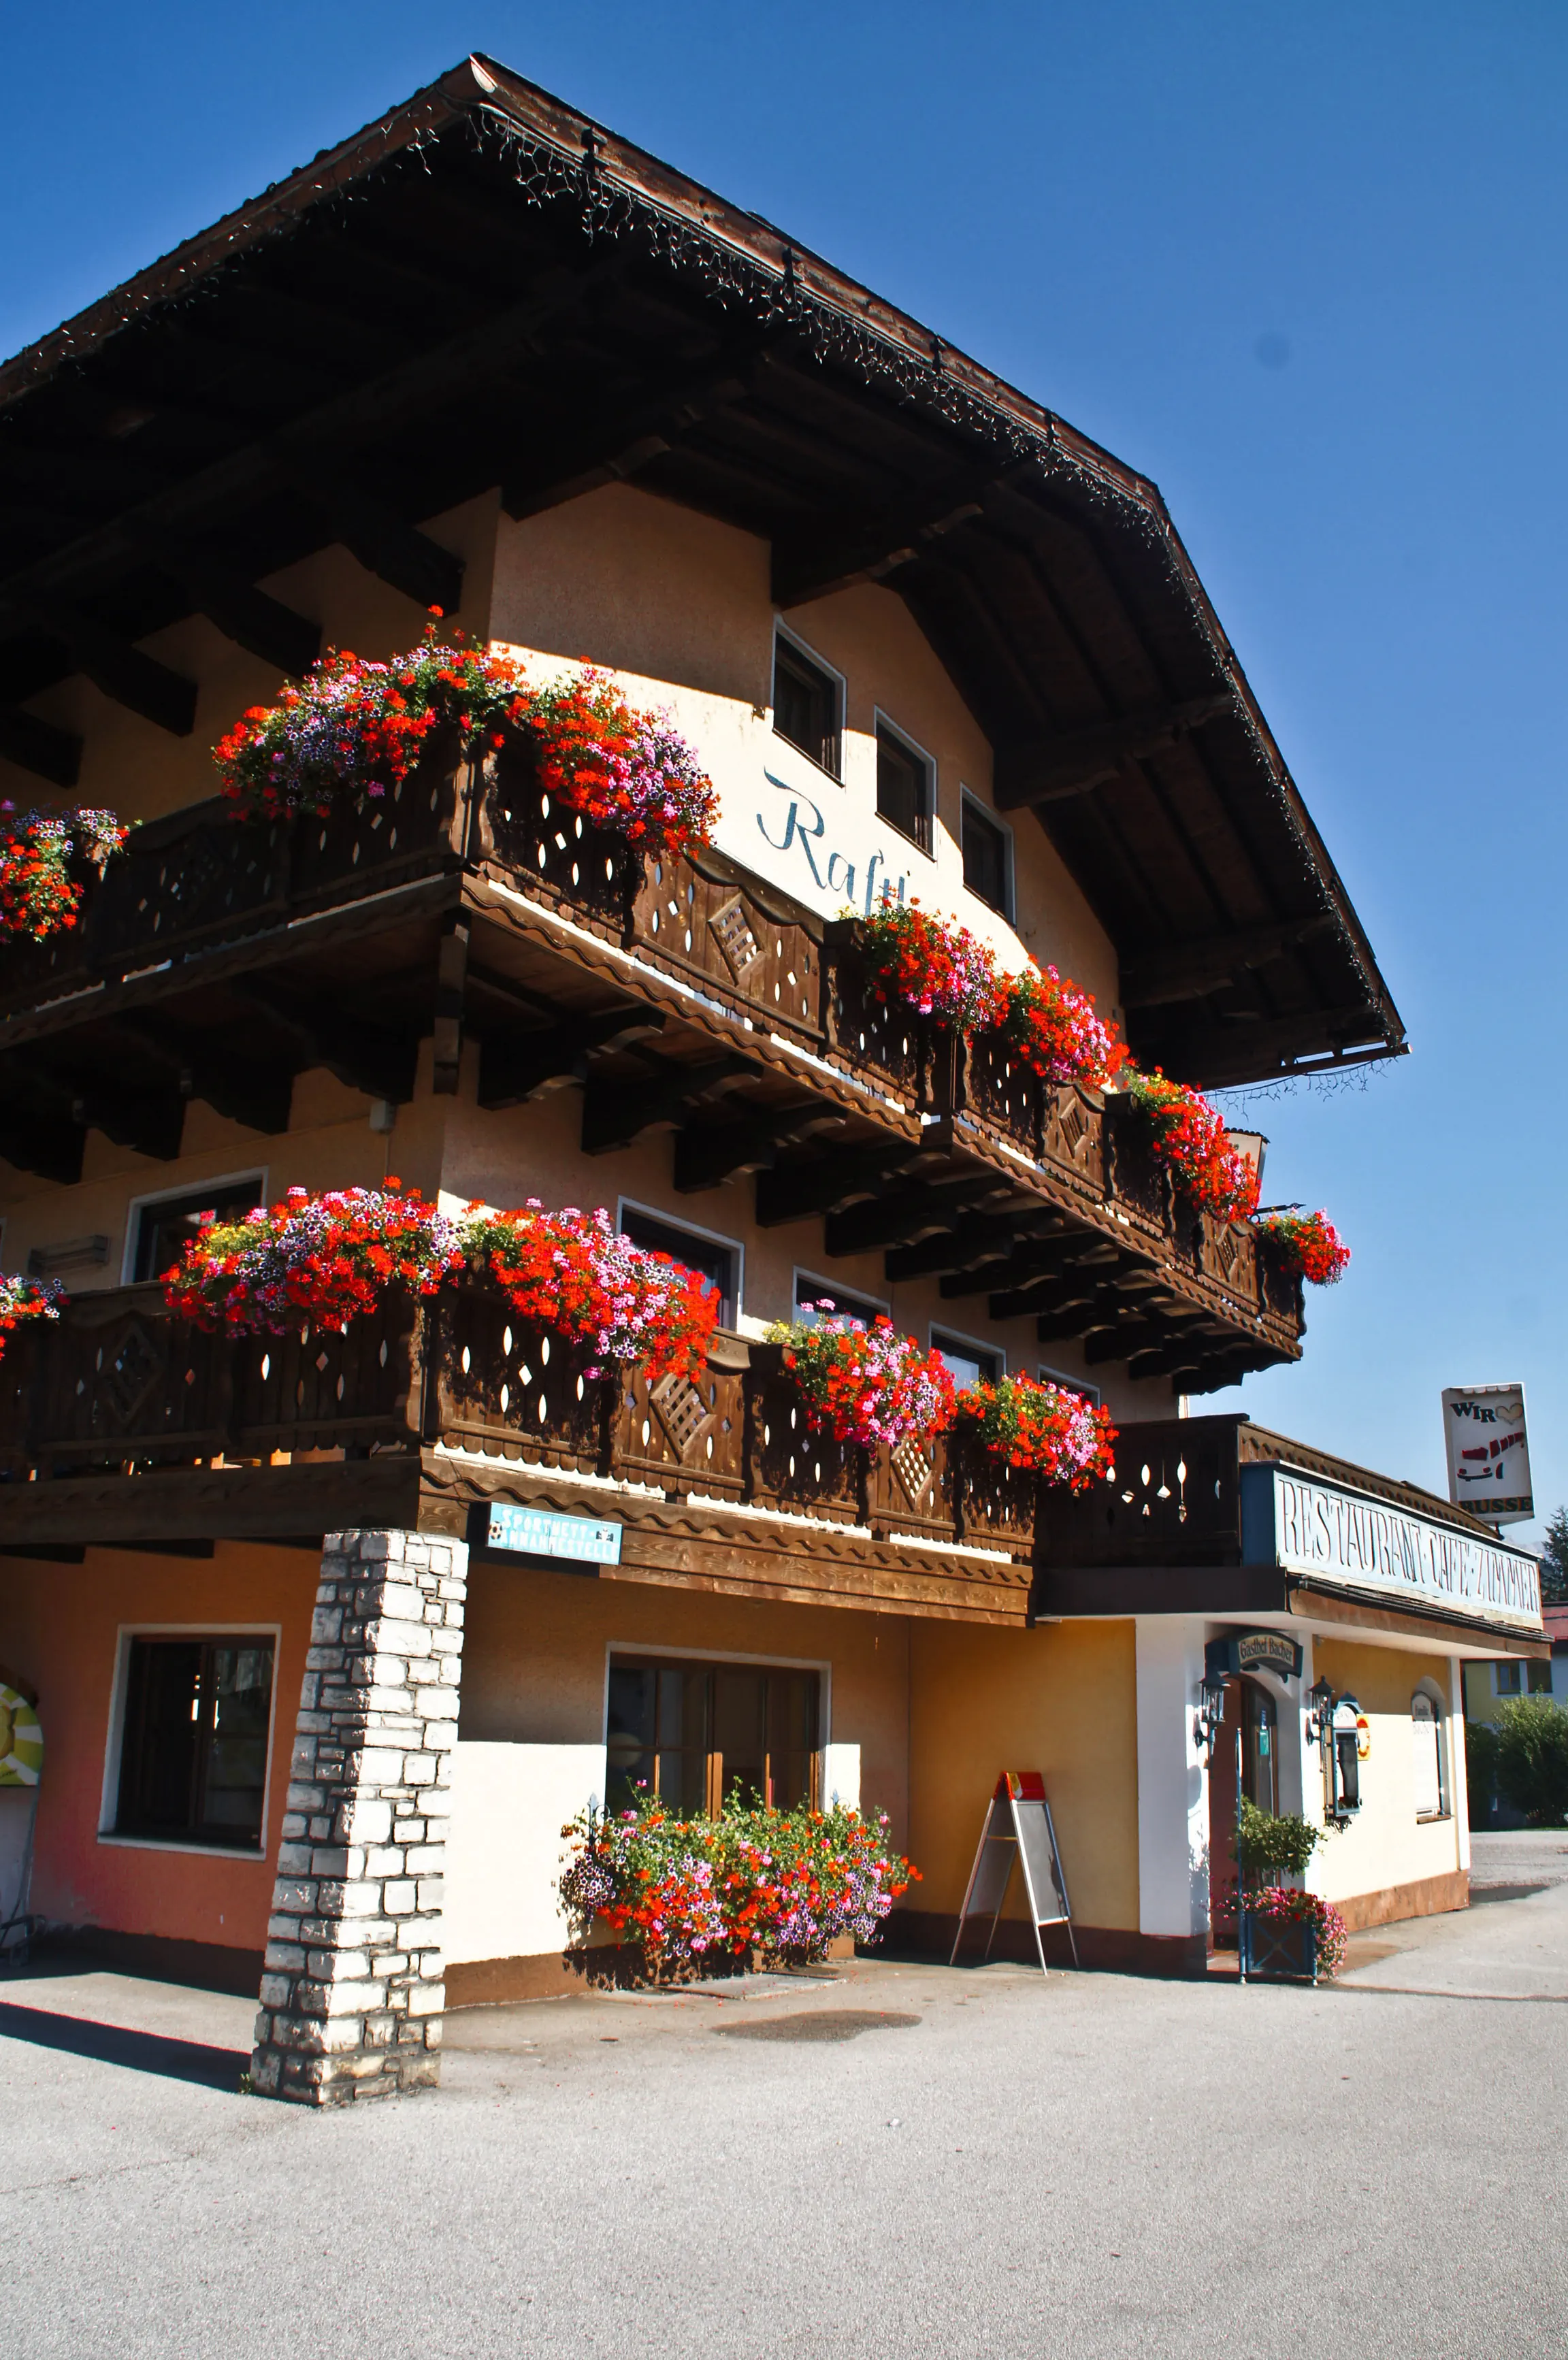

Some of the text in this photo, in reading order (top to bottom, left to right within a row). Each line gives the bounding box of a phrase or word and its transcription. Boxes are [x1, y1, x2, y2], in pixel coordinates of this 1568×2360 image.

[1450, 1401, 1497, 1423] WIR
[1278, 1478, 1425, 1584] RESTAURANT
[1475, 1545, 1539, 1613] ZIMMER
